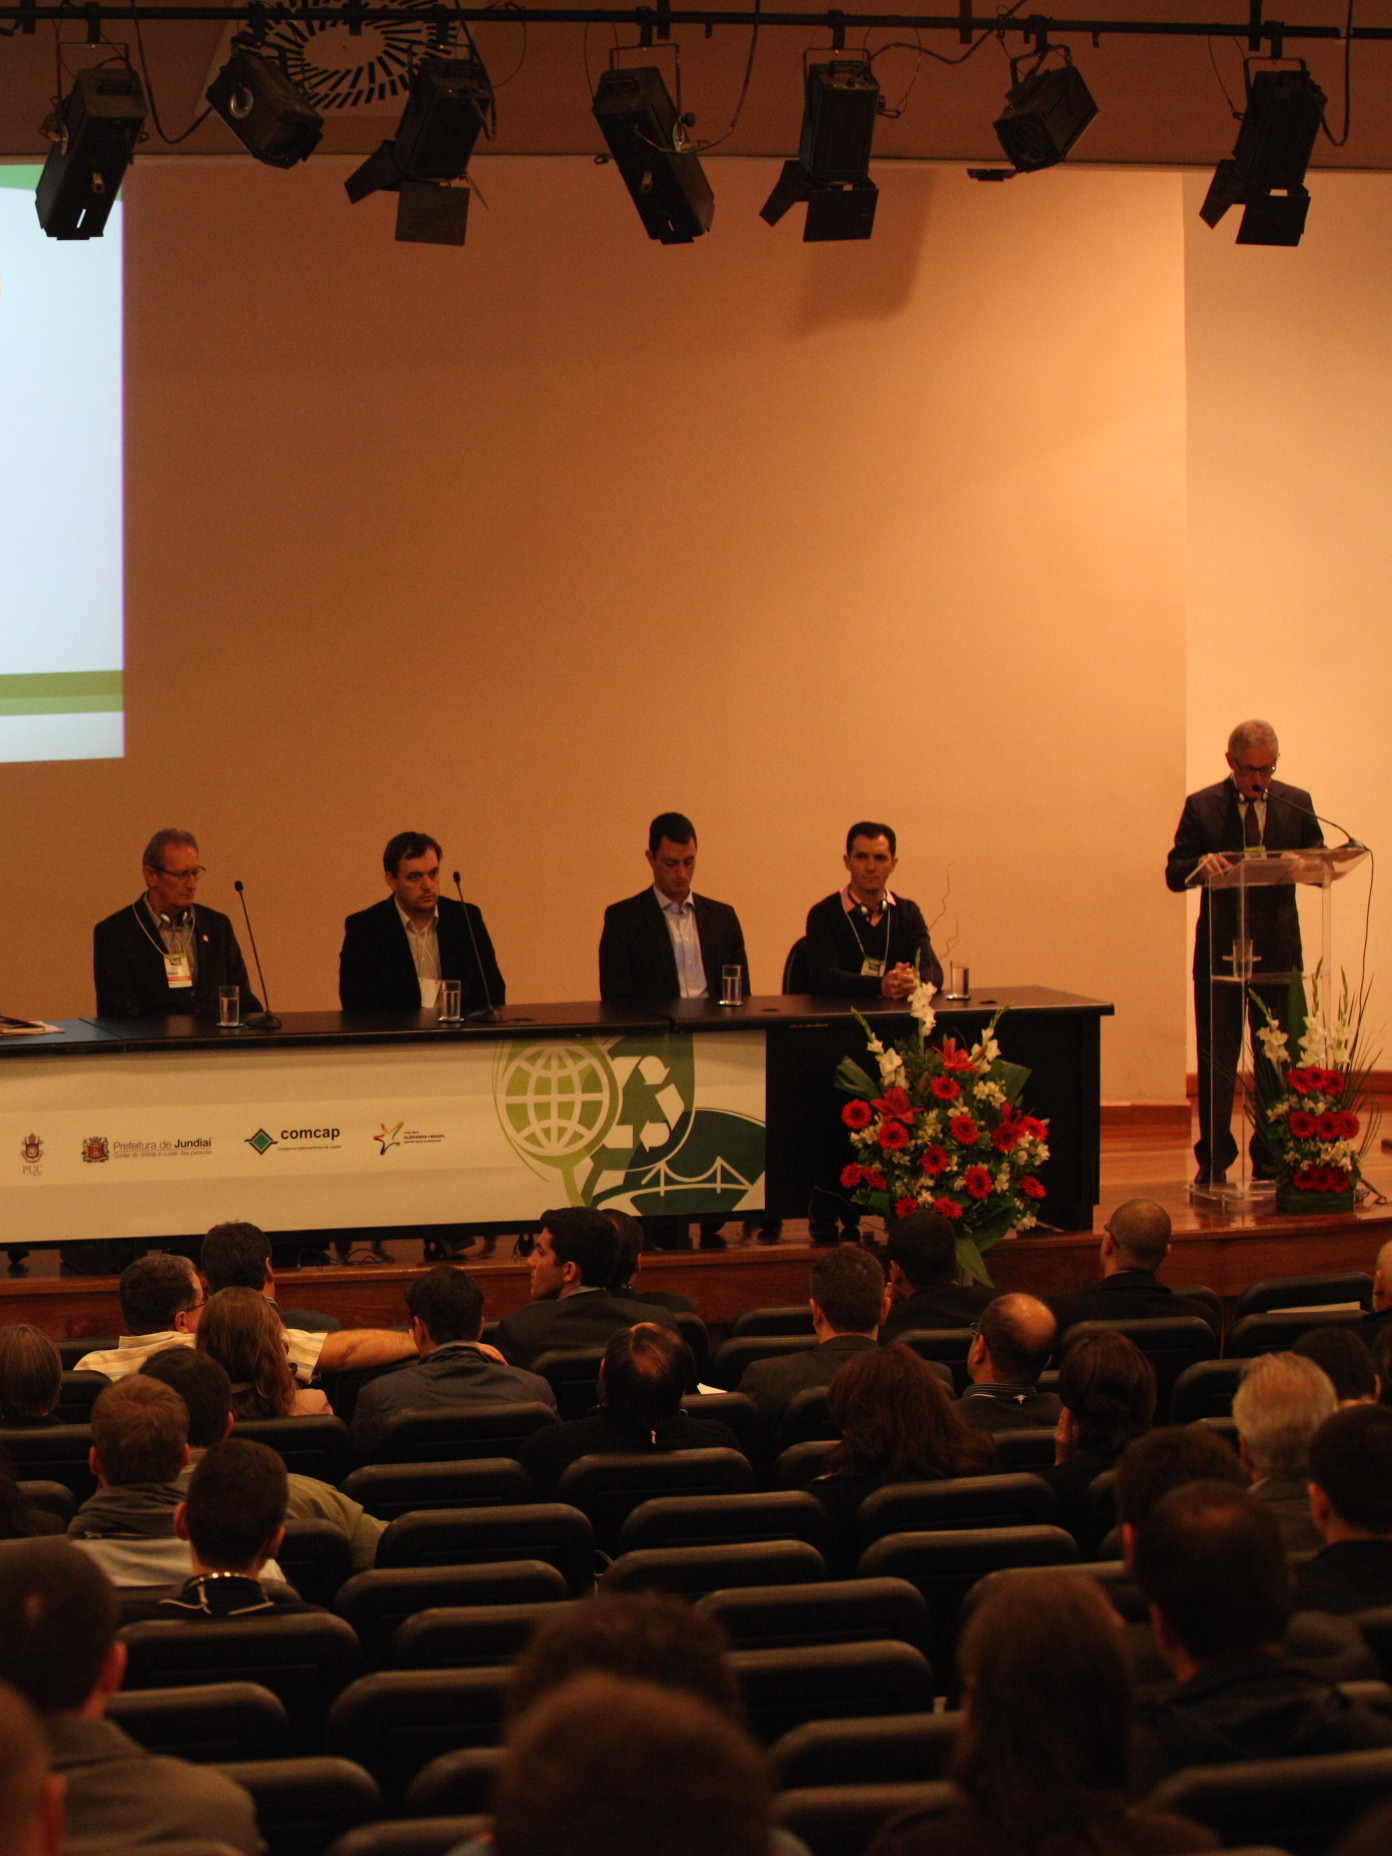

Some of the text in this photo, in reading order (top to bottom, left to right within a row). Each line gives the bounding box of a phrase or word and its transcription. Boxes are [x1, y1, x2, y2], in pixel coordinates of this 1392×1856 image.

[281, 1128, 340, 1141] comcap
[113, 1137, 212, 1151] Prefeitura de Jundiaí
[22, 1165, 43, 1174] PUC
